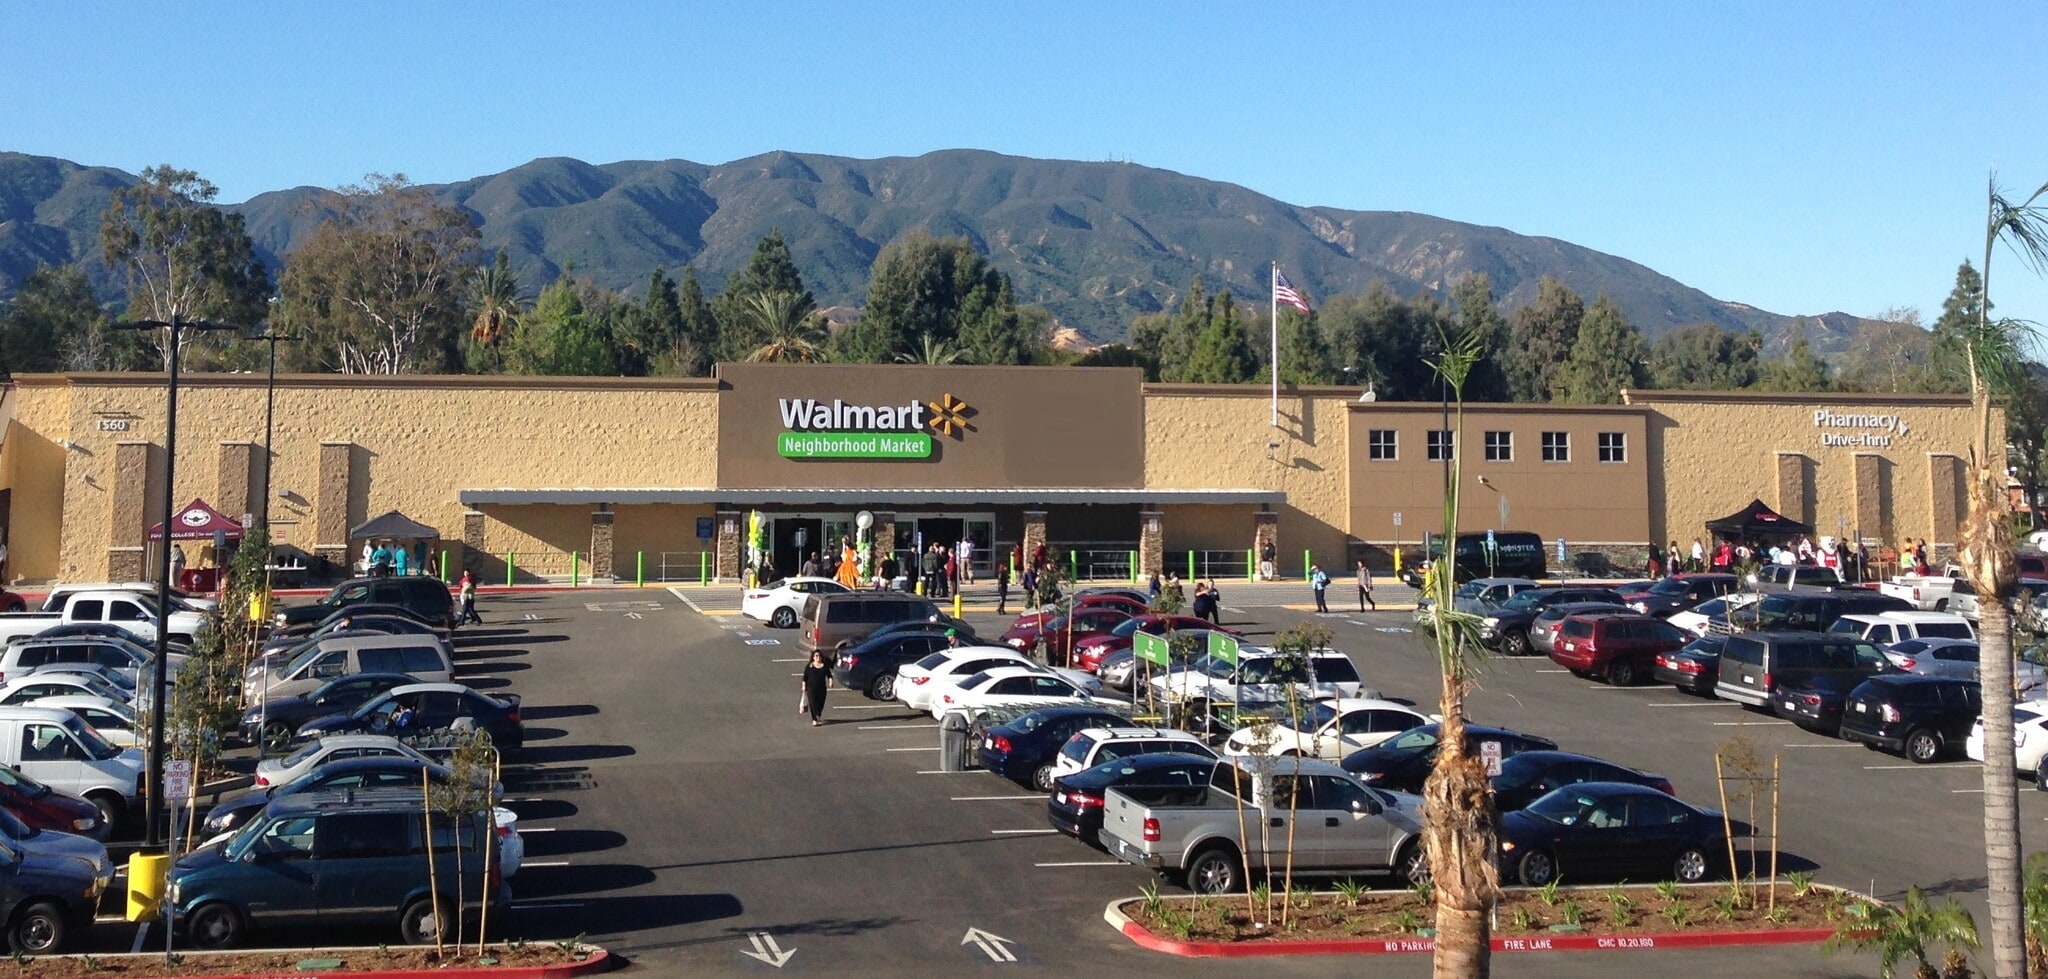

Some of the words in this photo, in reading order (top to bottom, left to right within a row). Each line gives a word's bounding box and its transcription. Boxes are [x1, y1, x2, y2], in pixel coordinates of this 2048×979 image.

[779, 399, 924, 429] Walmart
[96, 420, 125, 430] 1560
[1814, 409, 1898, 432] Pharmacy
[1822, 433, 1890, 446] Drive-Thru
[785, 438, 875, 456] Neighborhood
[880, 438, 925, 453] Market
[1500, 544, 1536, 552] MONSTER
[1385, 942, 1398, 951] NO
[1504, 940, 1525, 950] FIRE
[1529, 940, 1552, 949] LANE
[1598, 938, 1616, 947] CMC
